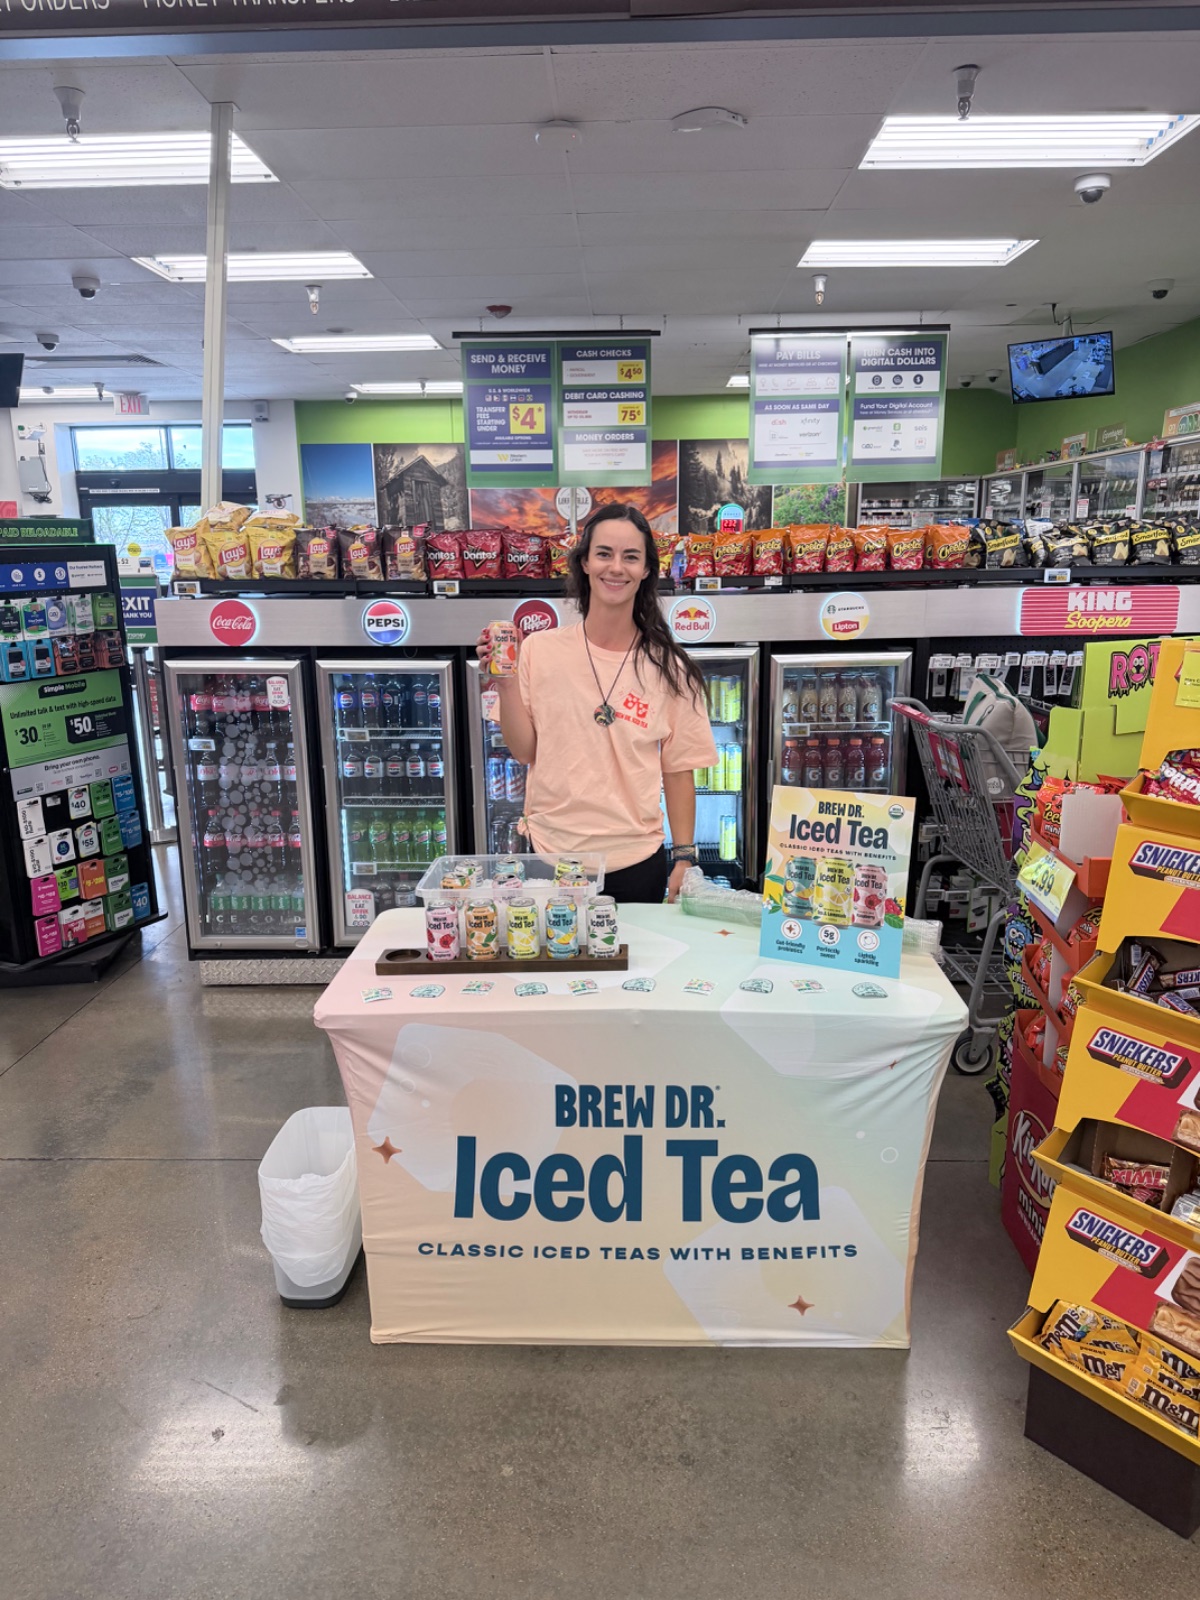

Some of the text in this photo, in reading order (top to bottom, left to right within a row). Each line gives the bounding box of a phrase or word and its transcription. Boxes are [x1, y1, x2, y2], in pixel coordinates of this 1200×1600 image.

[776, 350, 821, 360] PAY BILLS
[862, 347, 936, 358] TURN CASH INTO
[470, 354, 546, 363] SEND & RECEIVE
[861, 356, 936, 366] DIGITAL DOLLARS
[492, 364, 526, 374] MONEY
[120, 396, 141, 414] EXIT
[20, 528, 78, 537] RELOADABLE
[174, 536, 196, 550] Lay's
[310, 542, 328, 553] Lay's
[397, 541, 416, 552] Lay's
[826, 538, 853, 558] Cheetos
[893, 539, 922, 557] Cheetos
[988, 536, 1019, 549] Smartfood
[260, 546, 282, 558] Lay's
[754, 540, 781, 558] Cheetos
[795, 540, 824, 557] Cheetos
[938, 540, 968, 560] Cheetos
[222, 546, 245, 563] Lay's
[350, 549, 368, 560] Lay's
[463, 550, 497, 560] Doritos
[507, 553, 539, 563] Doritos
[1068, 591, 1132, 611] KING
[212, 615, 253, 630] Coca-Cola
[367, 618, 404, 628] PEPSI
[532, 614, 543, 622] Dr
[1064, 611, 1133, 632] Soopers
[522, 618, 550, 631] Pepper
[675, 621, 710, 631] Red Bull
[834, 621, 858, 632] Lipton
[44, 682, 85, 693] Simple Mobile
[10, 709, 37, 719] Unlimited
[37, 706, 48, 714] talk
[78, 698, 104, 708] high-speed
[809, 770, 818, 781] G
[828, 770, 839, 781] G
[818, 801, 865, 818] BREW DR.
[789, 814, 889, 850] Iced Tea
[779, 842, 808, 851] CLASSIC
[864, 851, 896, 861] BENEFITS
[789, 870, 804, 879] Iced
[1156, 865, 1180, 878] PEANUT
[820, 873, 850, 884] Iced Tea
[855, 879, 882, 889] Iced Tea
[206, 915, 237, 923] ICE
[428, 922, 442, 930] Iced
[823, 929, 835, 940] 5g
[776, 939, 806, 949] Gut-friendly
[778, 946, 803, 954] probiotics
[816, 946, 840, 955] Perfectly
[858, 952, 876, 960] Lightly
[854, 958, 879, 967] sparkling
[1094, 1030, 1179, 1074] SNICKERS
[1113, 1054, 1136, 1068] PEANUT
[1138, 1061, 1163, 1077] BUTTER
[555, 1084, 726, 1128] BREW DR.
[454, 1134, 820, 1224] Iced Tea
[1111, 1168, 1164, 1188] TWIX
[1072, 1211, 1157, 1264] SNICKERS
[418, 1242, 858, 1261] CLASSIC ICED TEAS WITH BENEFITS
[1091, 1236, 1113, 1252] PEANUT
[1115, 1246, 1141, 1266] BUTTER
